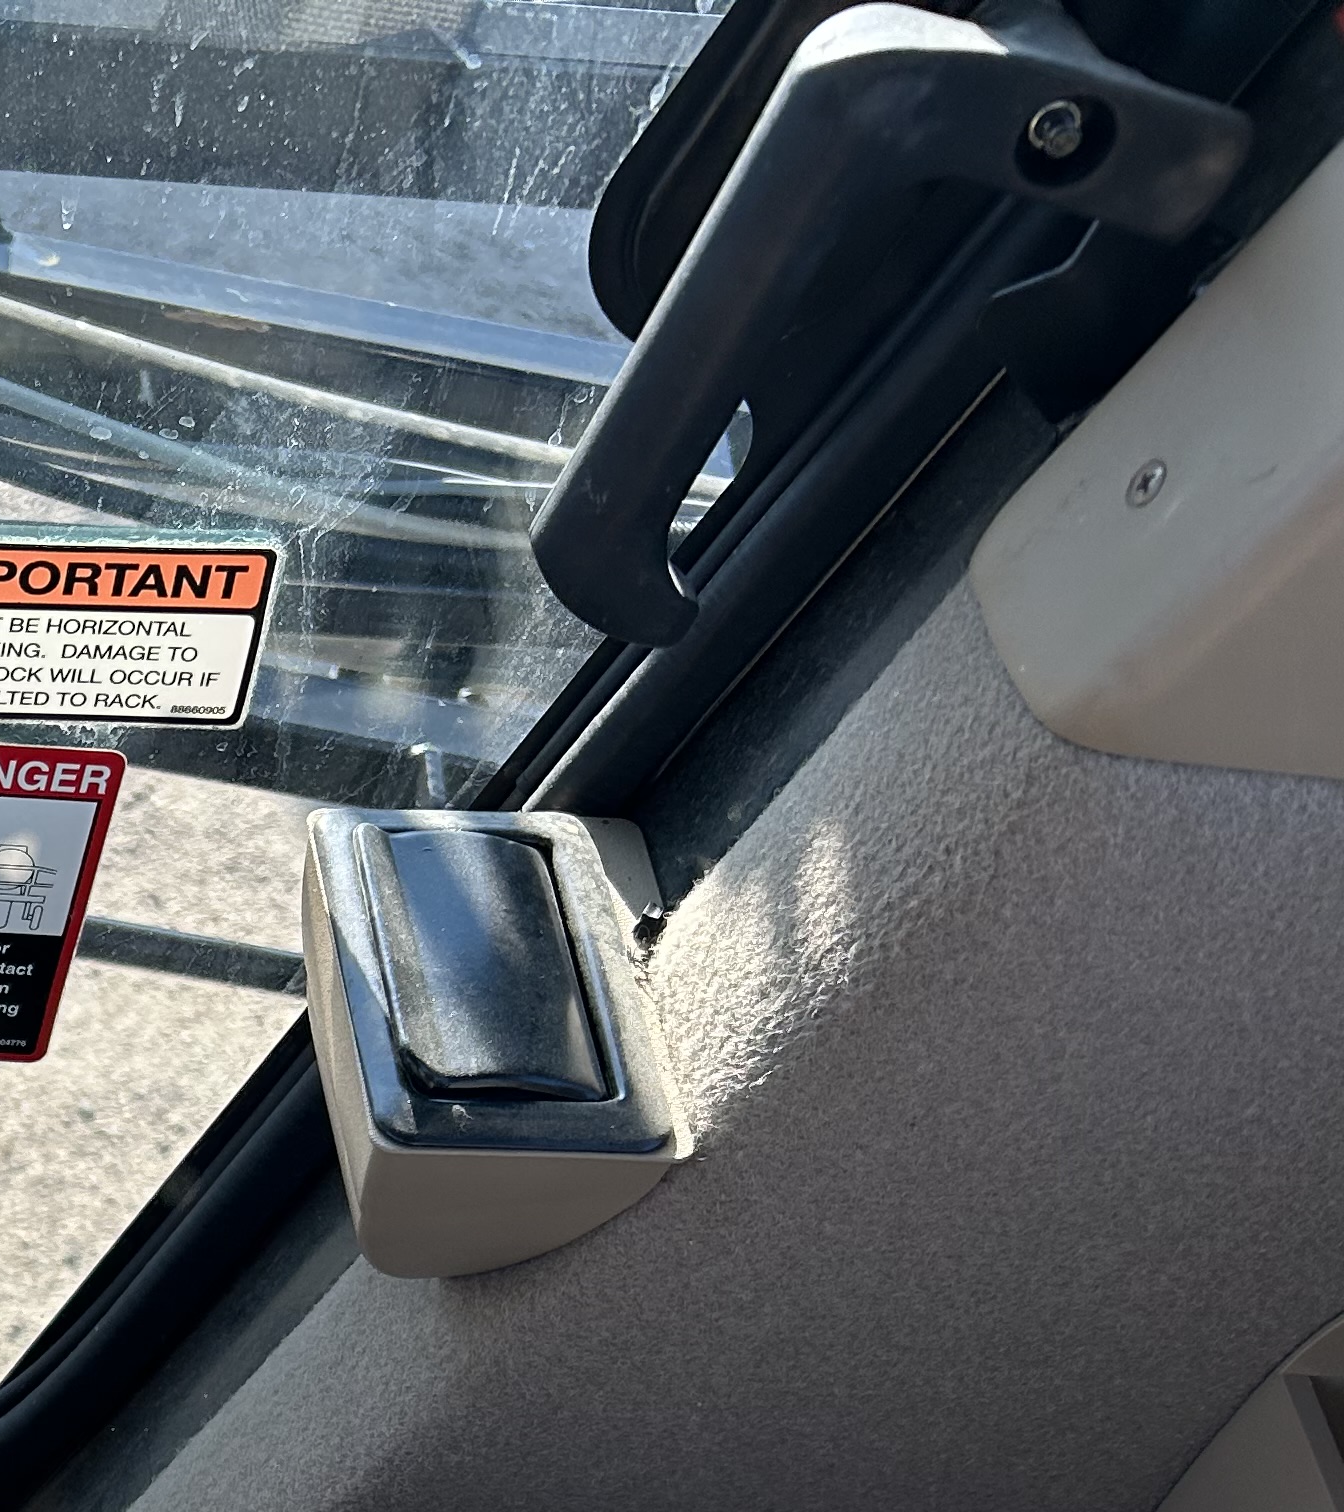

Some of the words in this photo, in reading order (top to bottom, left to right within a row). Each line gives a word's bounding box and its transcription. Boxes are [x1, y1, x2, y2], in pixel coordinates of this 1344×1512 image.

[9, 617, 40, 634] BE
[46, 618, 192, 637] HORIZONTAL
[61, 644, 161, 661] DAMAGE
[170, 646, 198, 662] TO
[50, 668, 102, 684] WILL
[109, 669, 193, 686] OCCUR
[199, 672, 220, 687] IF
[57, 693, 86, 708] TO
[93, 693, 161, 709] RACK.
